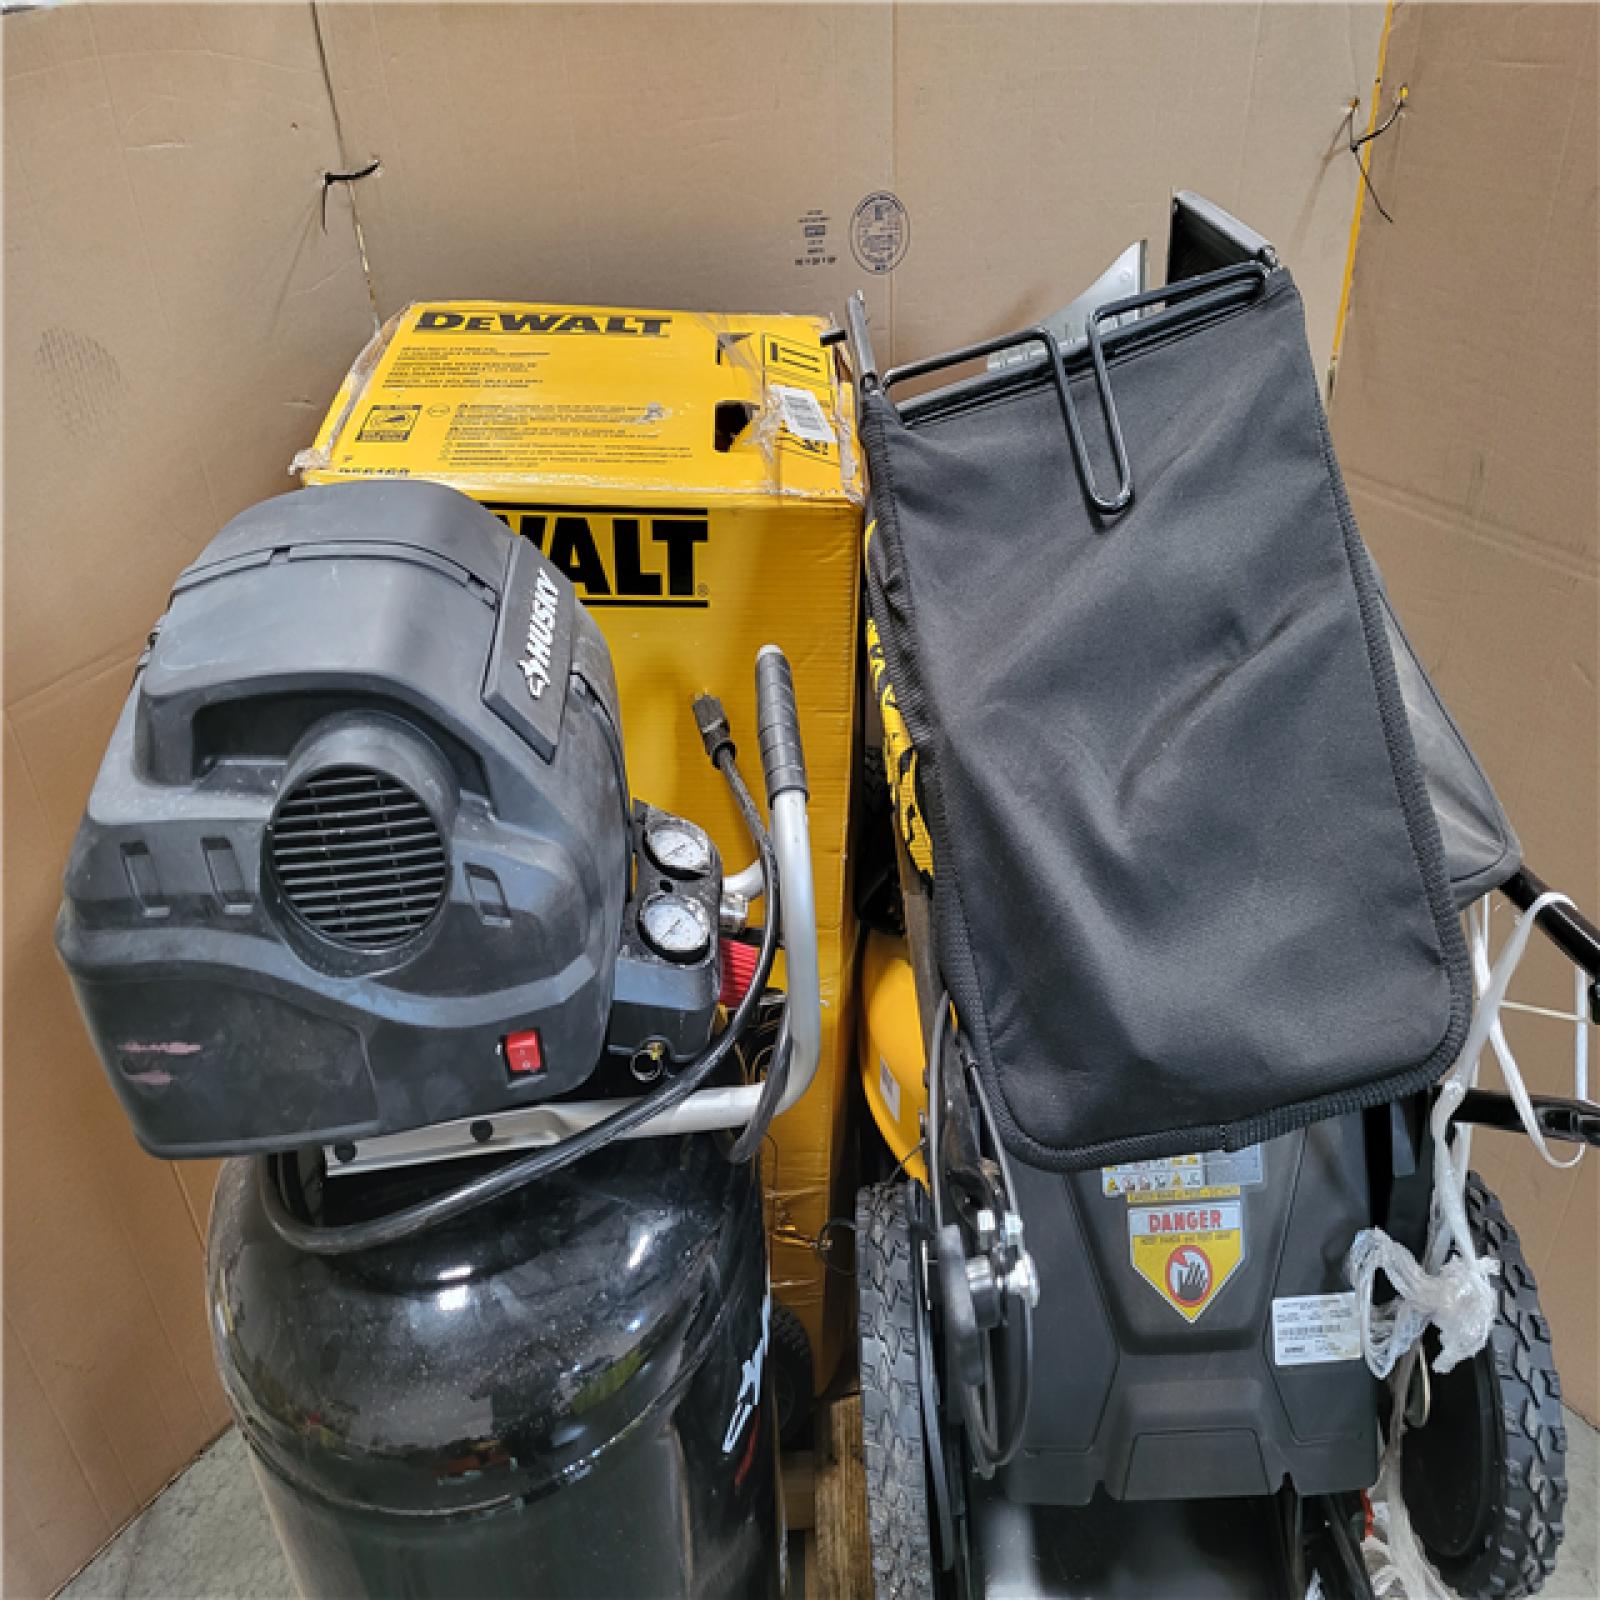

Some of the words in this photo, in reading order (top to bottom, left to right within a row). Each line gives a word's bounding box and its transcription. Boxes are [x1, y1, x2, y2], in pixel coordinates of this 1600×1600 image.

[416, 312, 672, 337] DEWALT
[525, 567, 559, 668] HUSKY
[1148, 1209, 1221, 1232] DANGER
